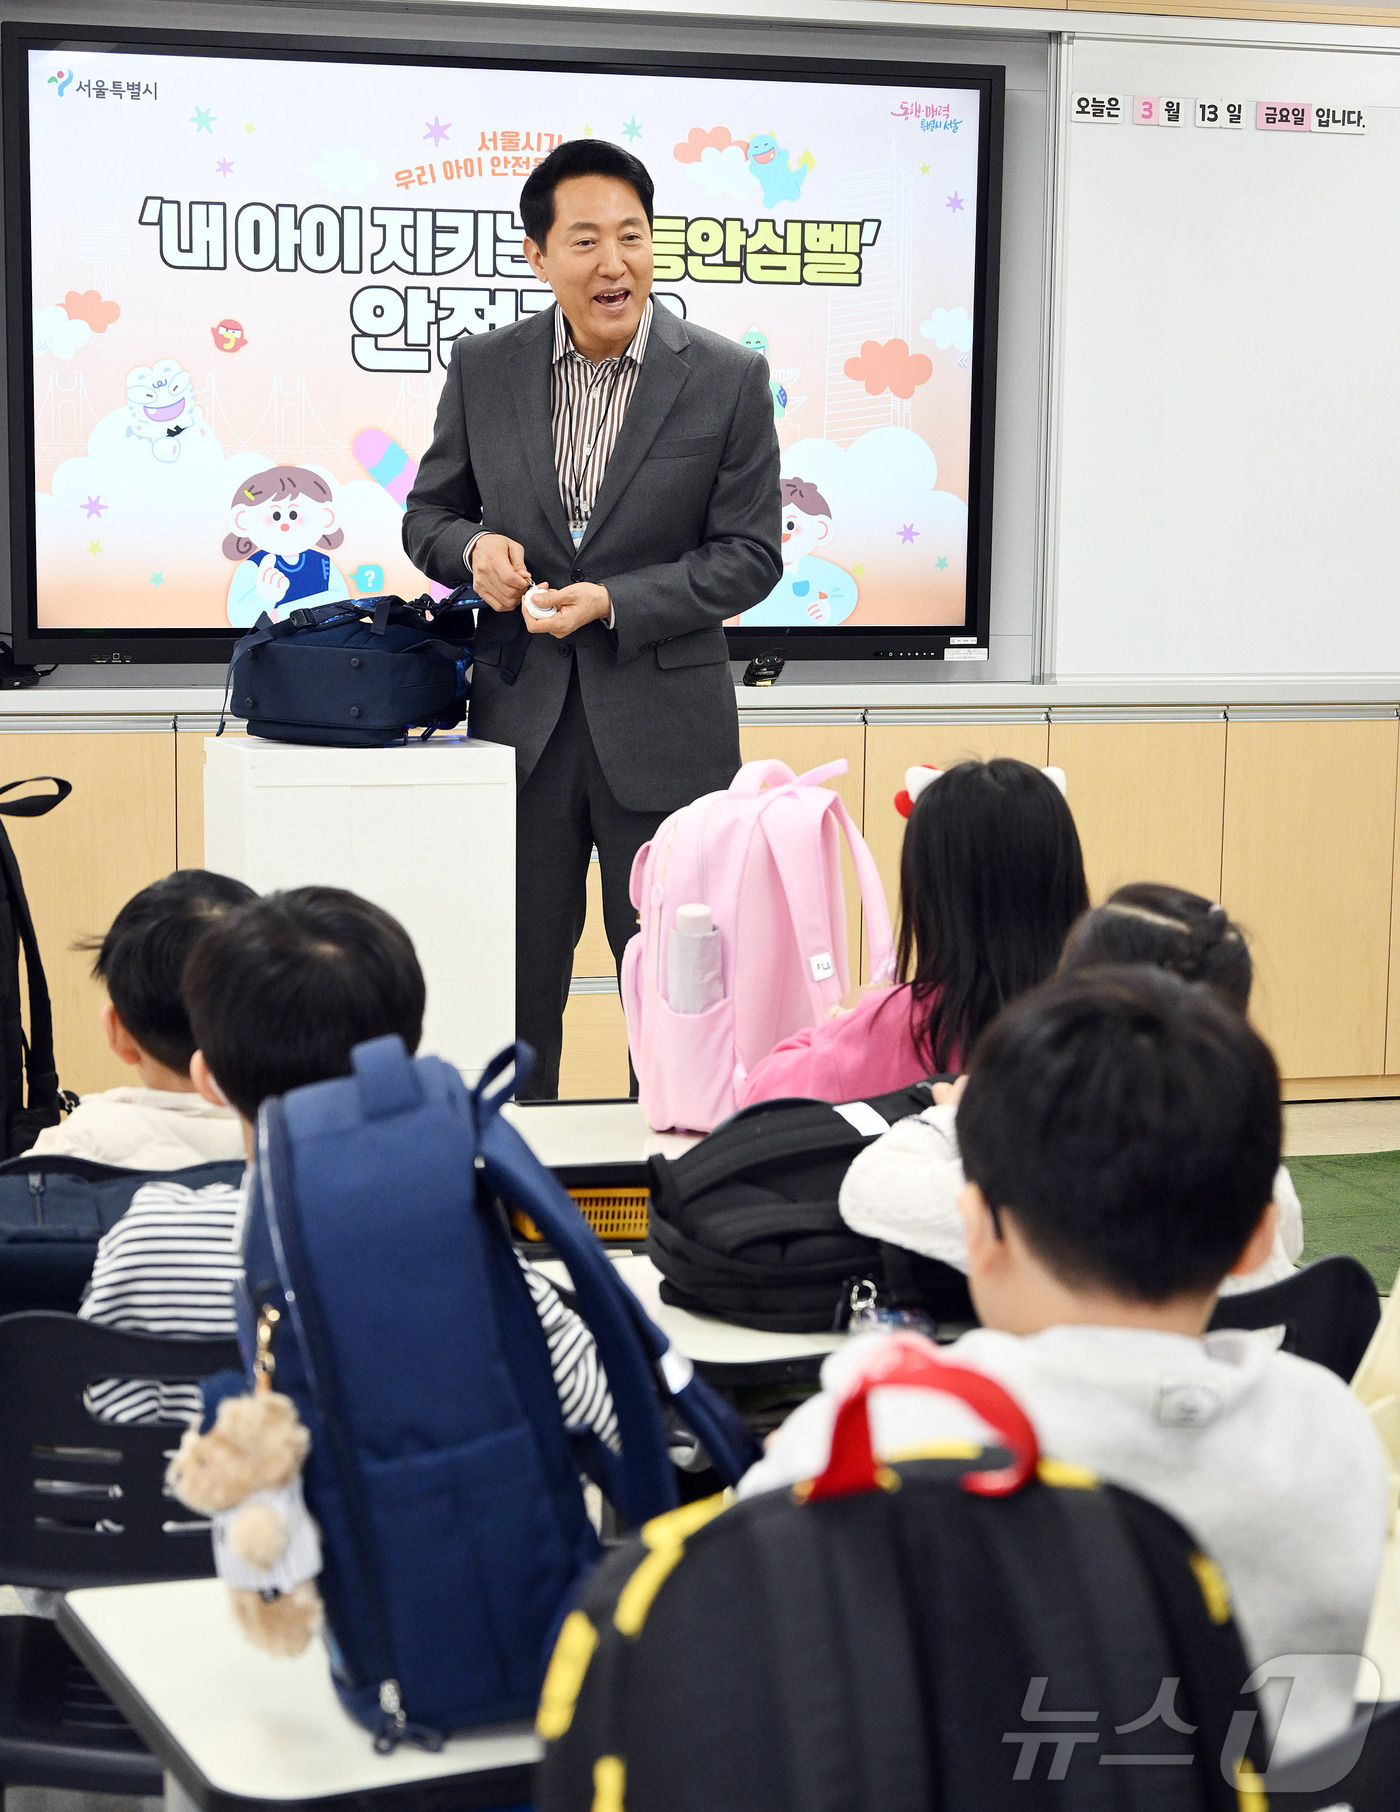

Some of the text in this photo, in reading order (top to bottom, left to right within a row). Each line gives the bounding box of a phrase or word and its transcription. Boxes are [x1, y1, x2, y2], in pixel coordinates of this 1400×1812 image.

[75, 79, 158, 101] 서울특별시
[943, 118, 963, 133] 서울
[1075, 97, 1366, 128] 오늘은 3 월 13 일 금요일 입니다.
[394, 163, 437, 190] 우리
[442, 156, 483, 181] 아이
[234, 202, 363, 274] 아이
[364, 569, 376, 588] ?
